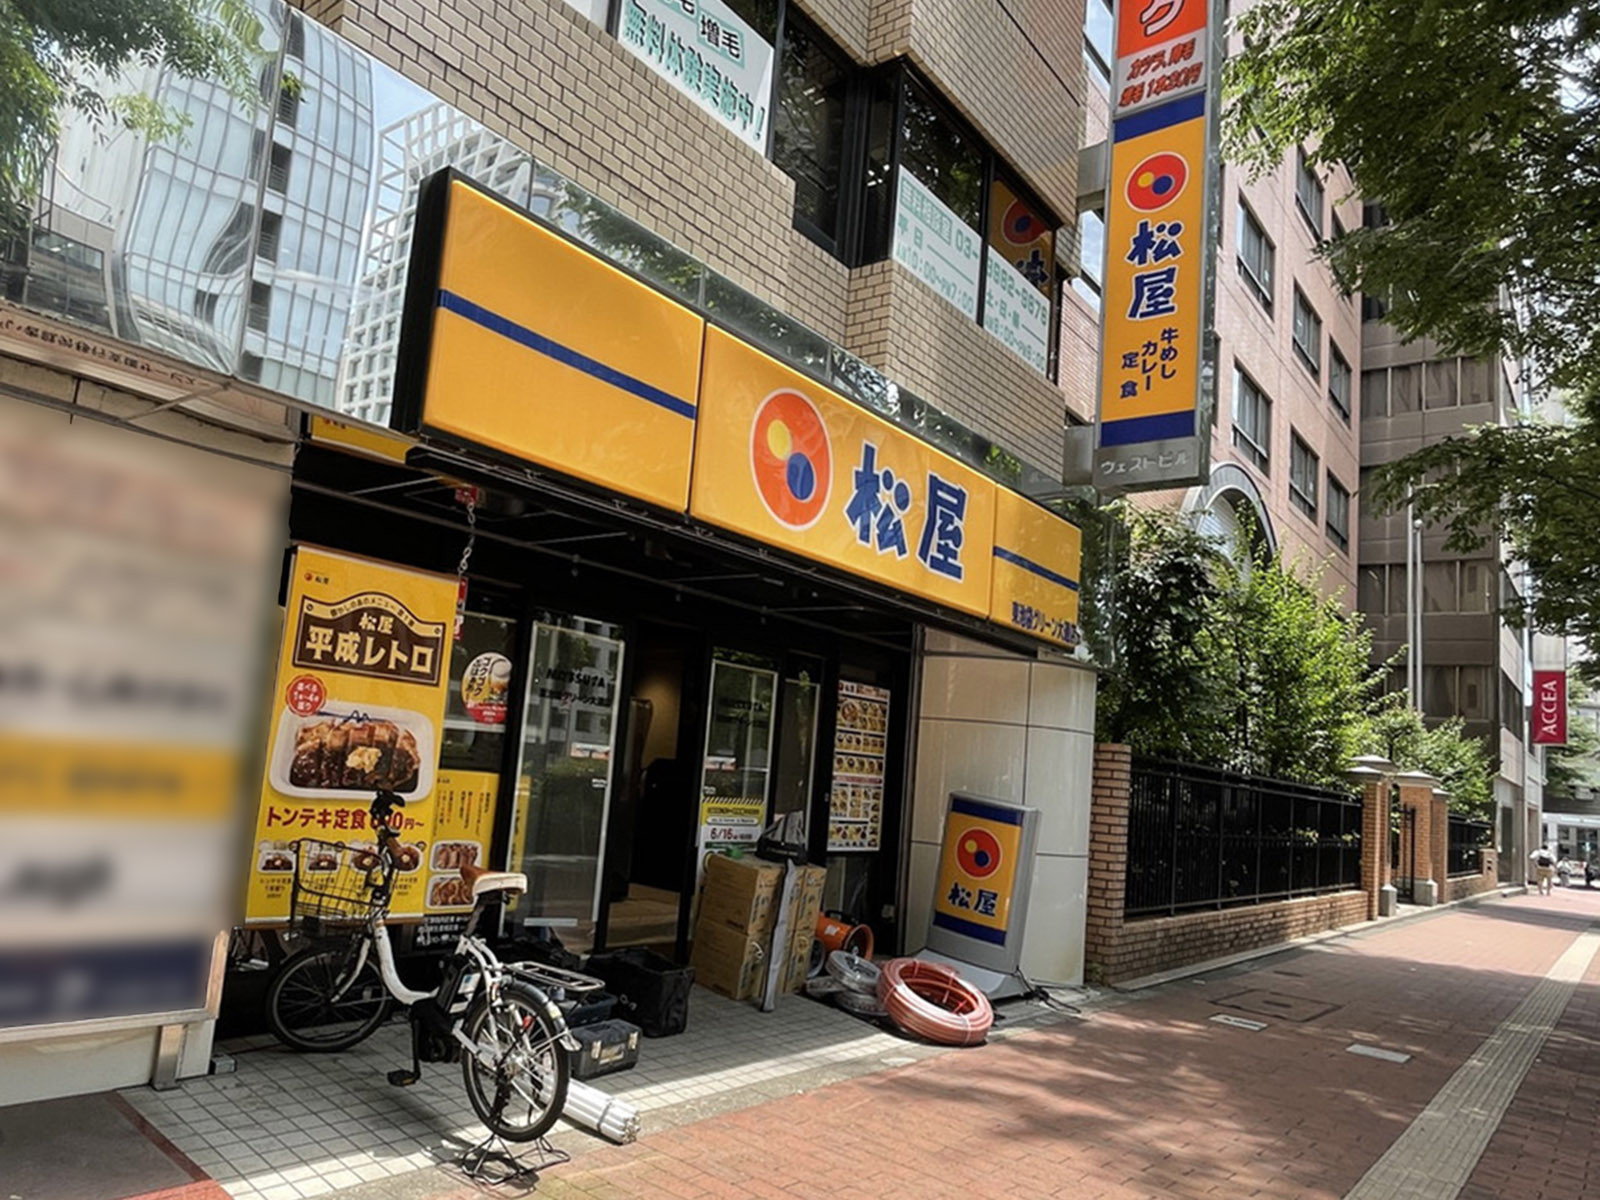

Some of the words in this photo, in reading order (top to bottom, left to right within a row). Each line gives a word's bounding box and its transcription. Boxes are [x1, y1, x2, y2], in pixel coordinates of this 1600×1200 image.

[700, 14, 740, 59] 増毛
[1124, 219, 1184, 321] 松屋
[1120, 351, 1139, 399] 定食
[1141, 340, 1158, 391] カレー
[1160, 328, 1179, 380] 牛めし
[845, 441, 967, 582] 松屋
[359, 612, 394, 634] 松屋
[305, 625, 434, 674] 平成レトロ
[1541, 680, 1558, 735] ACCEA
[267, 806, 365, 830] トンテキ定食
[948, 882, 998, 917] 松屋
